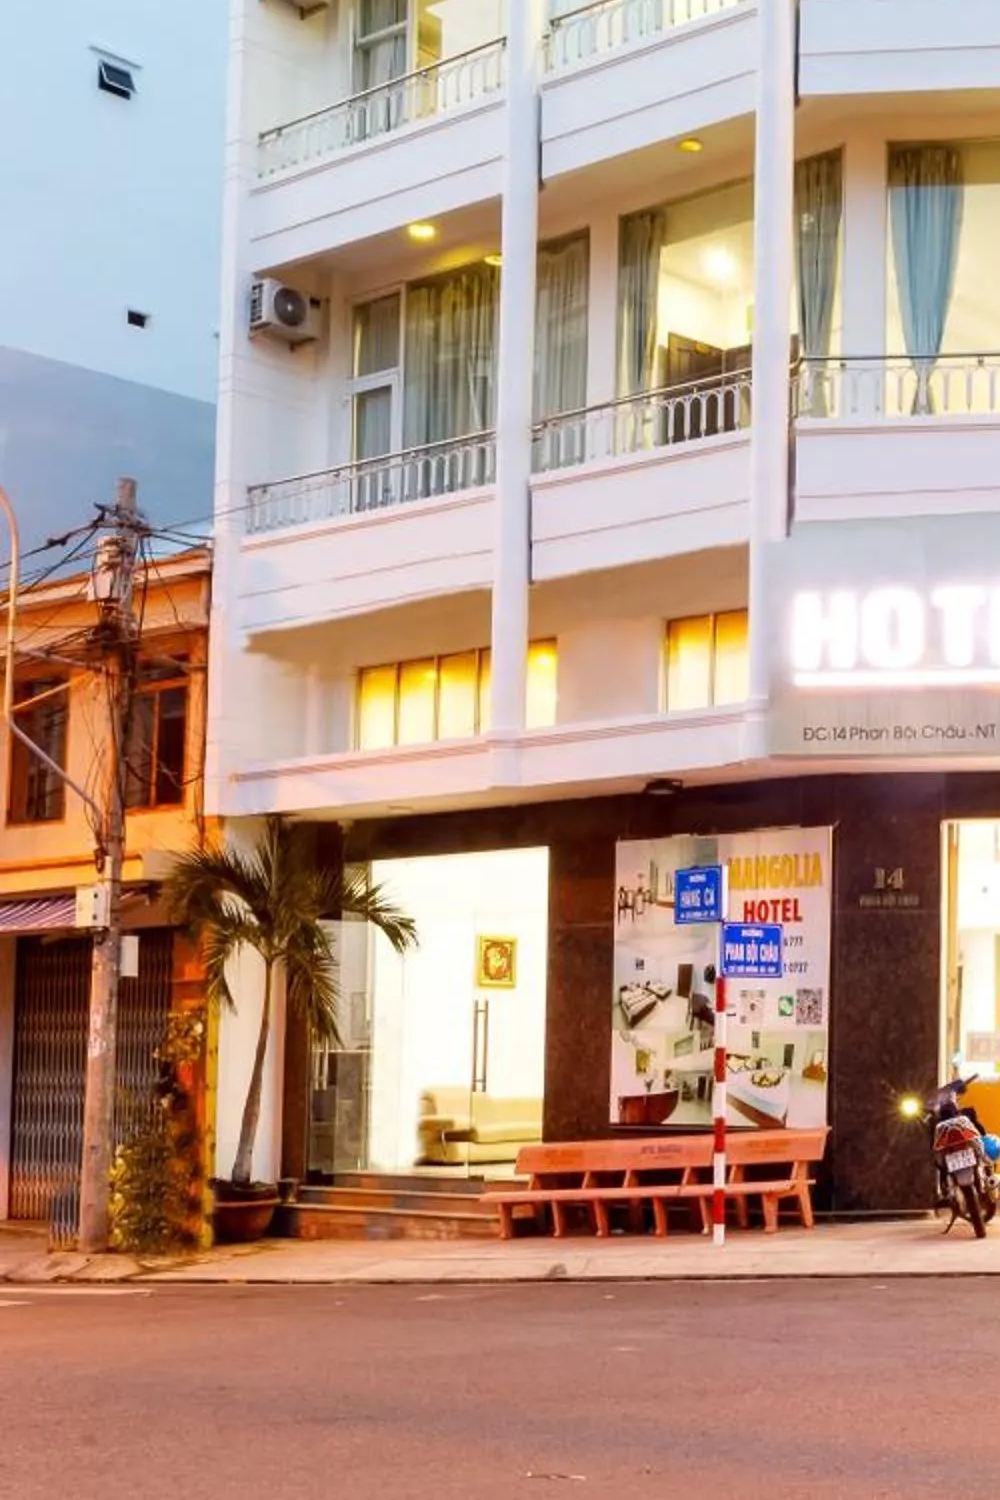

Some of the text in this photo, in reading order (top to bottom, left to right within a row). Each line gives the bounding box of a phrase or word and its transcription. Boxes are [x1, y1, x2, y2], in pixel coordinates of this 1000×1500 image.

[850, 726, 888, 742] Phan
[728, 852, 823, 890] MANGOLIA
[743, 899, 803, 924] HOTEL
